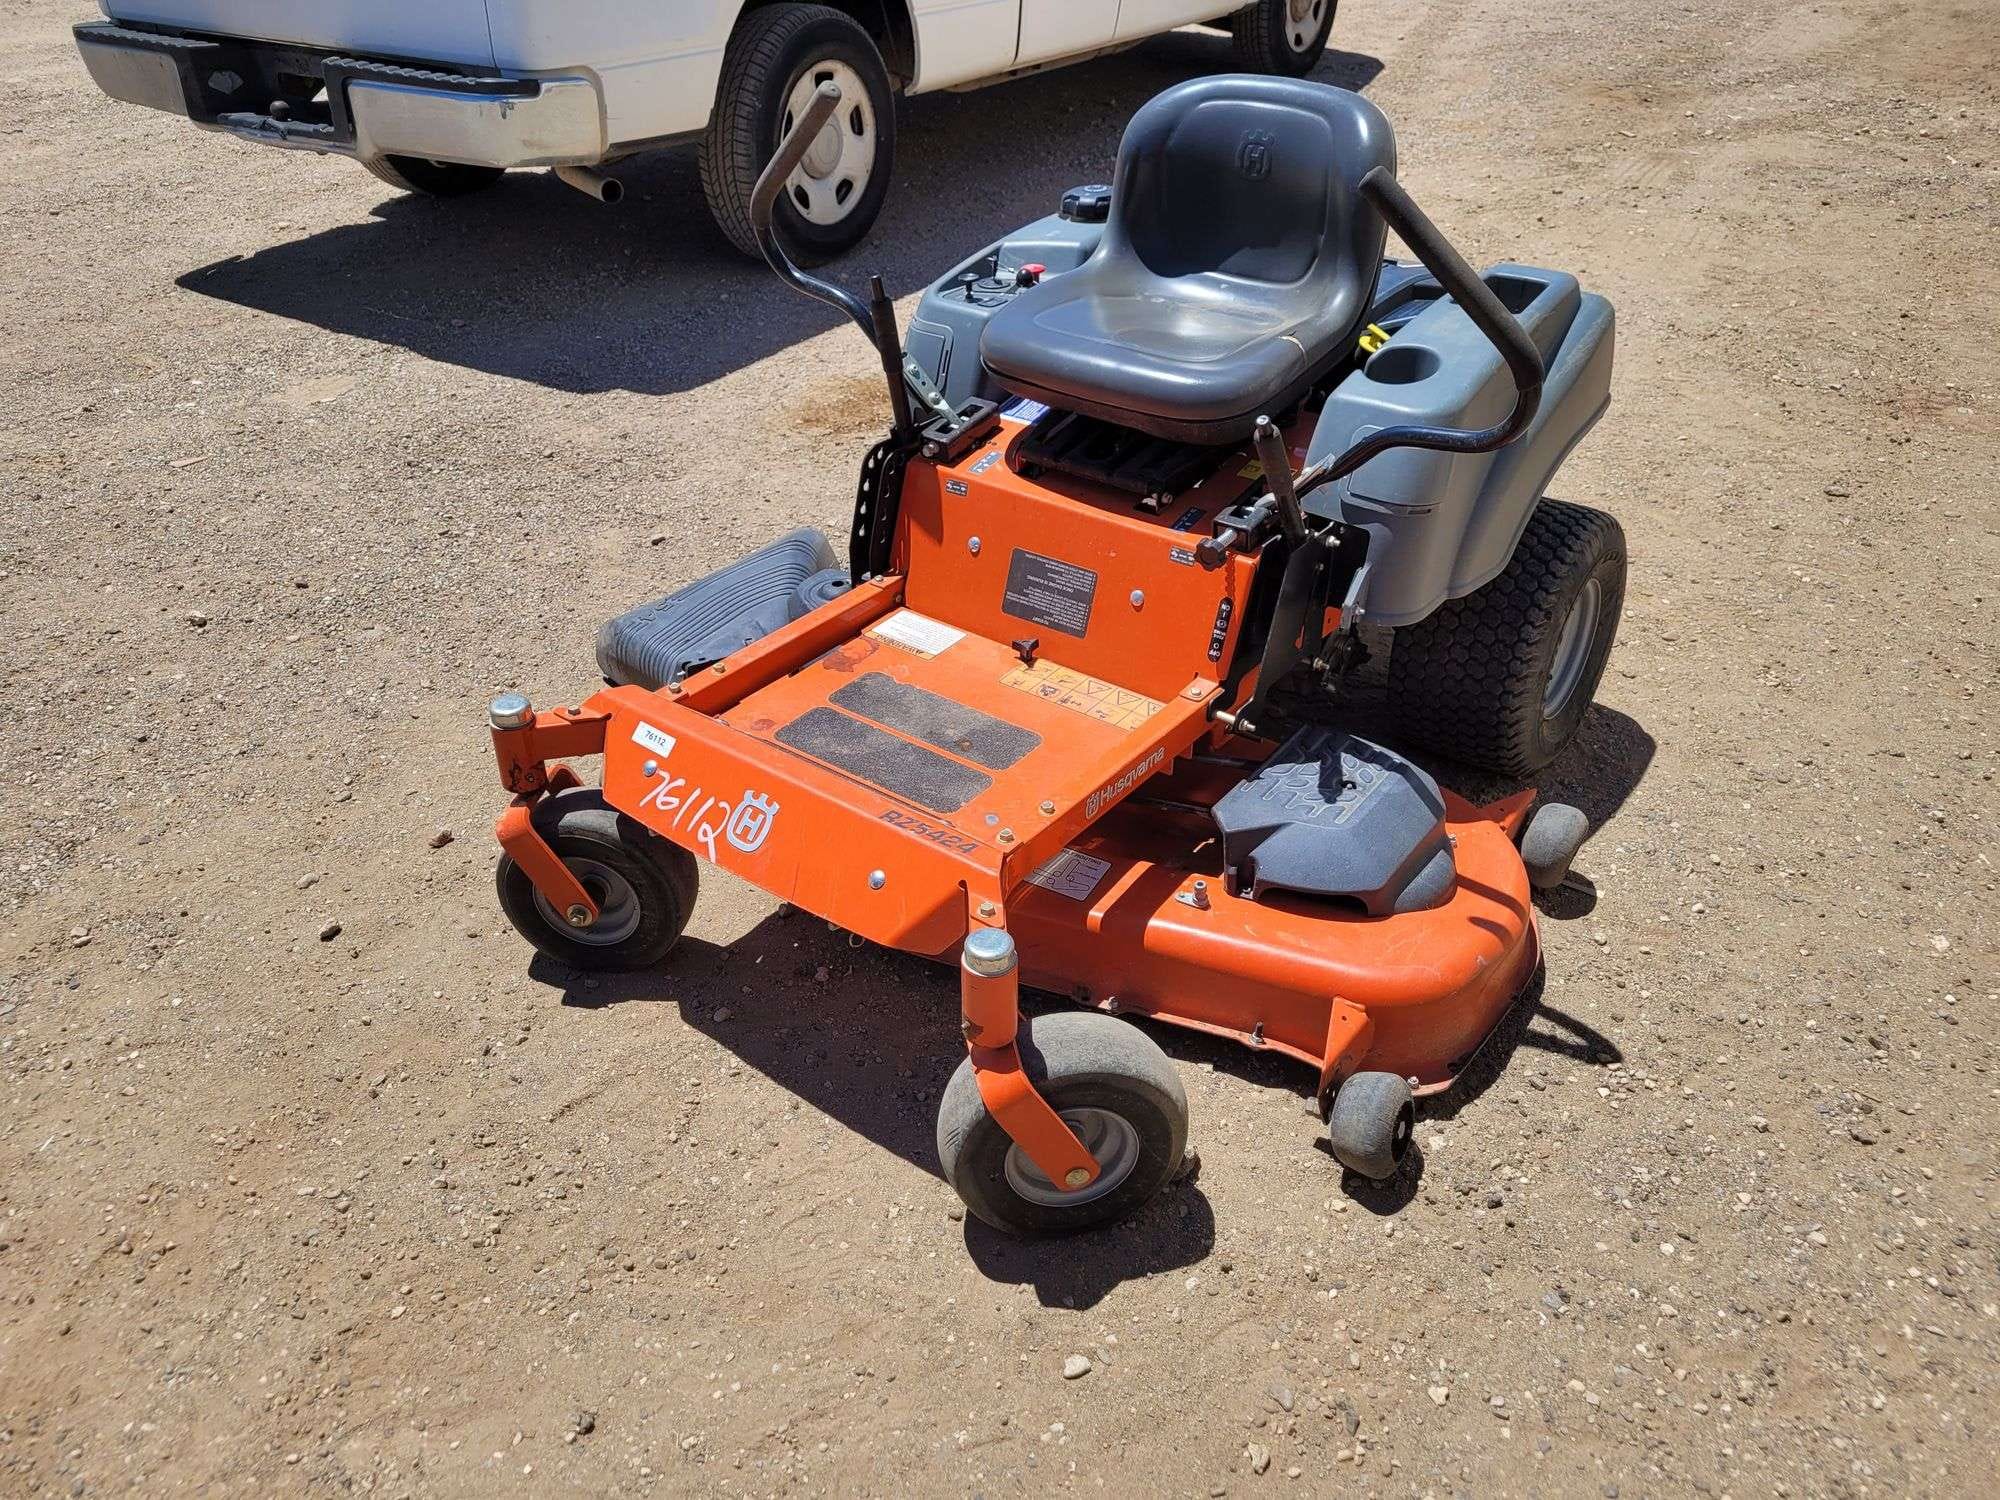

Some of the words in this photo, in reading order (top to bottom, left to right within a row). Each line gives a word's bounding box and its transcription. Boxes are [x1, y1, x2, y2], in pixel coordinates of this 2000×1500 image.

[644, 730, 667, 747] 76112
[1101, 747, 1165, 806] Husqvarna
[639, 769, 731, 863] 76112
[879, 810, 980, 853] RZ5424
